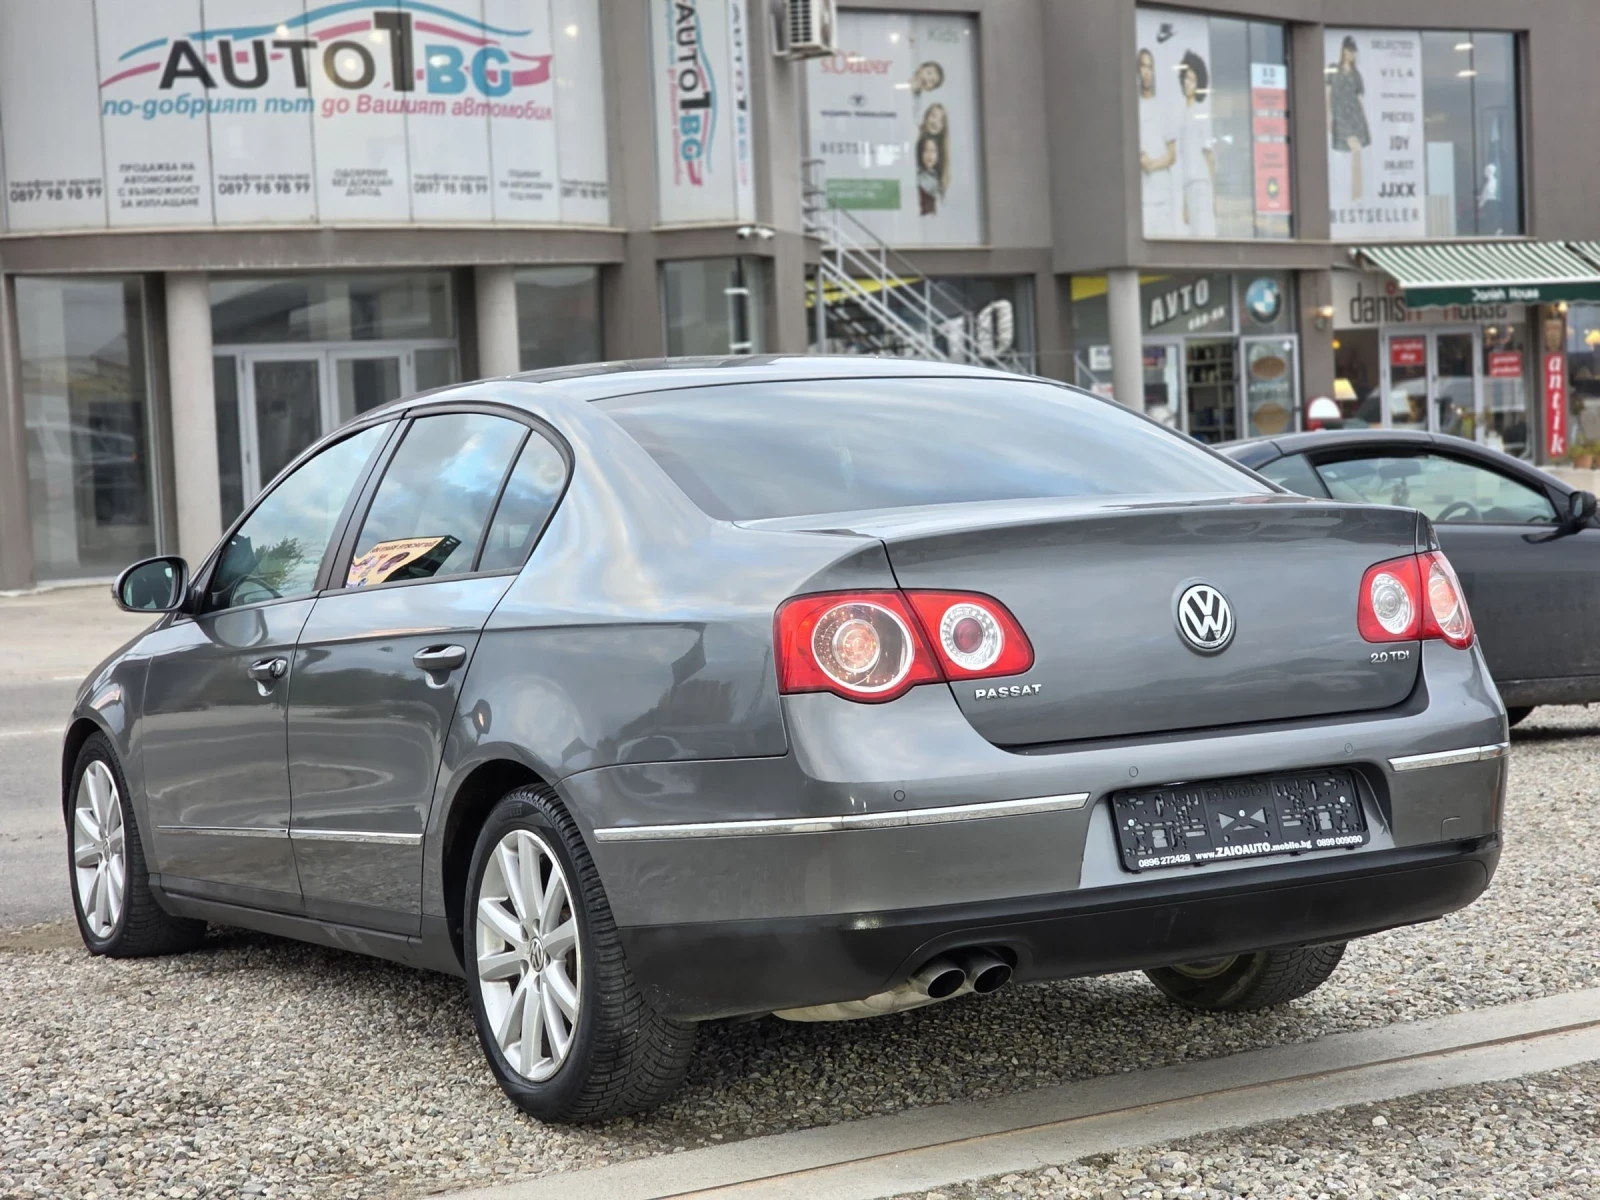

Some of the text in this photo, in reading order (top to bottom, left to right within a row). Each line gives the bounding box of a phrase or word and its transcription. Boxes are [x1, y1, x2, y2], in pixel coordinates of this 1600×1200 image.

[1380, 67, 1414, 78] VILA
[102, 92, 257, 120] по-добрият
[264, 96, 315, 114] път
[321, 97, 350, 118] до
[356, 94, 446, 116] Вашият
[10, 188, 42, 203] 0897
[218, 182, 250, 196] 0897
[1378, 182, 1415, 198] JJXX
[1389, 649, 1410, 662] TDI
[974, 683, 1042, 701] PASSAT
[1138, 857, 1160, 868] 0896
[1160, 853, 1191, 865] 272428
[1316, 837, 1335, 847] 0899
[1335, 835, 1363, 845] 009090
